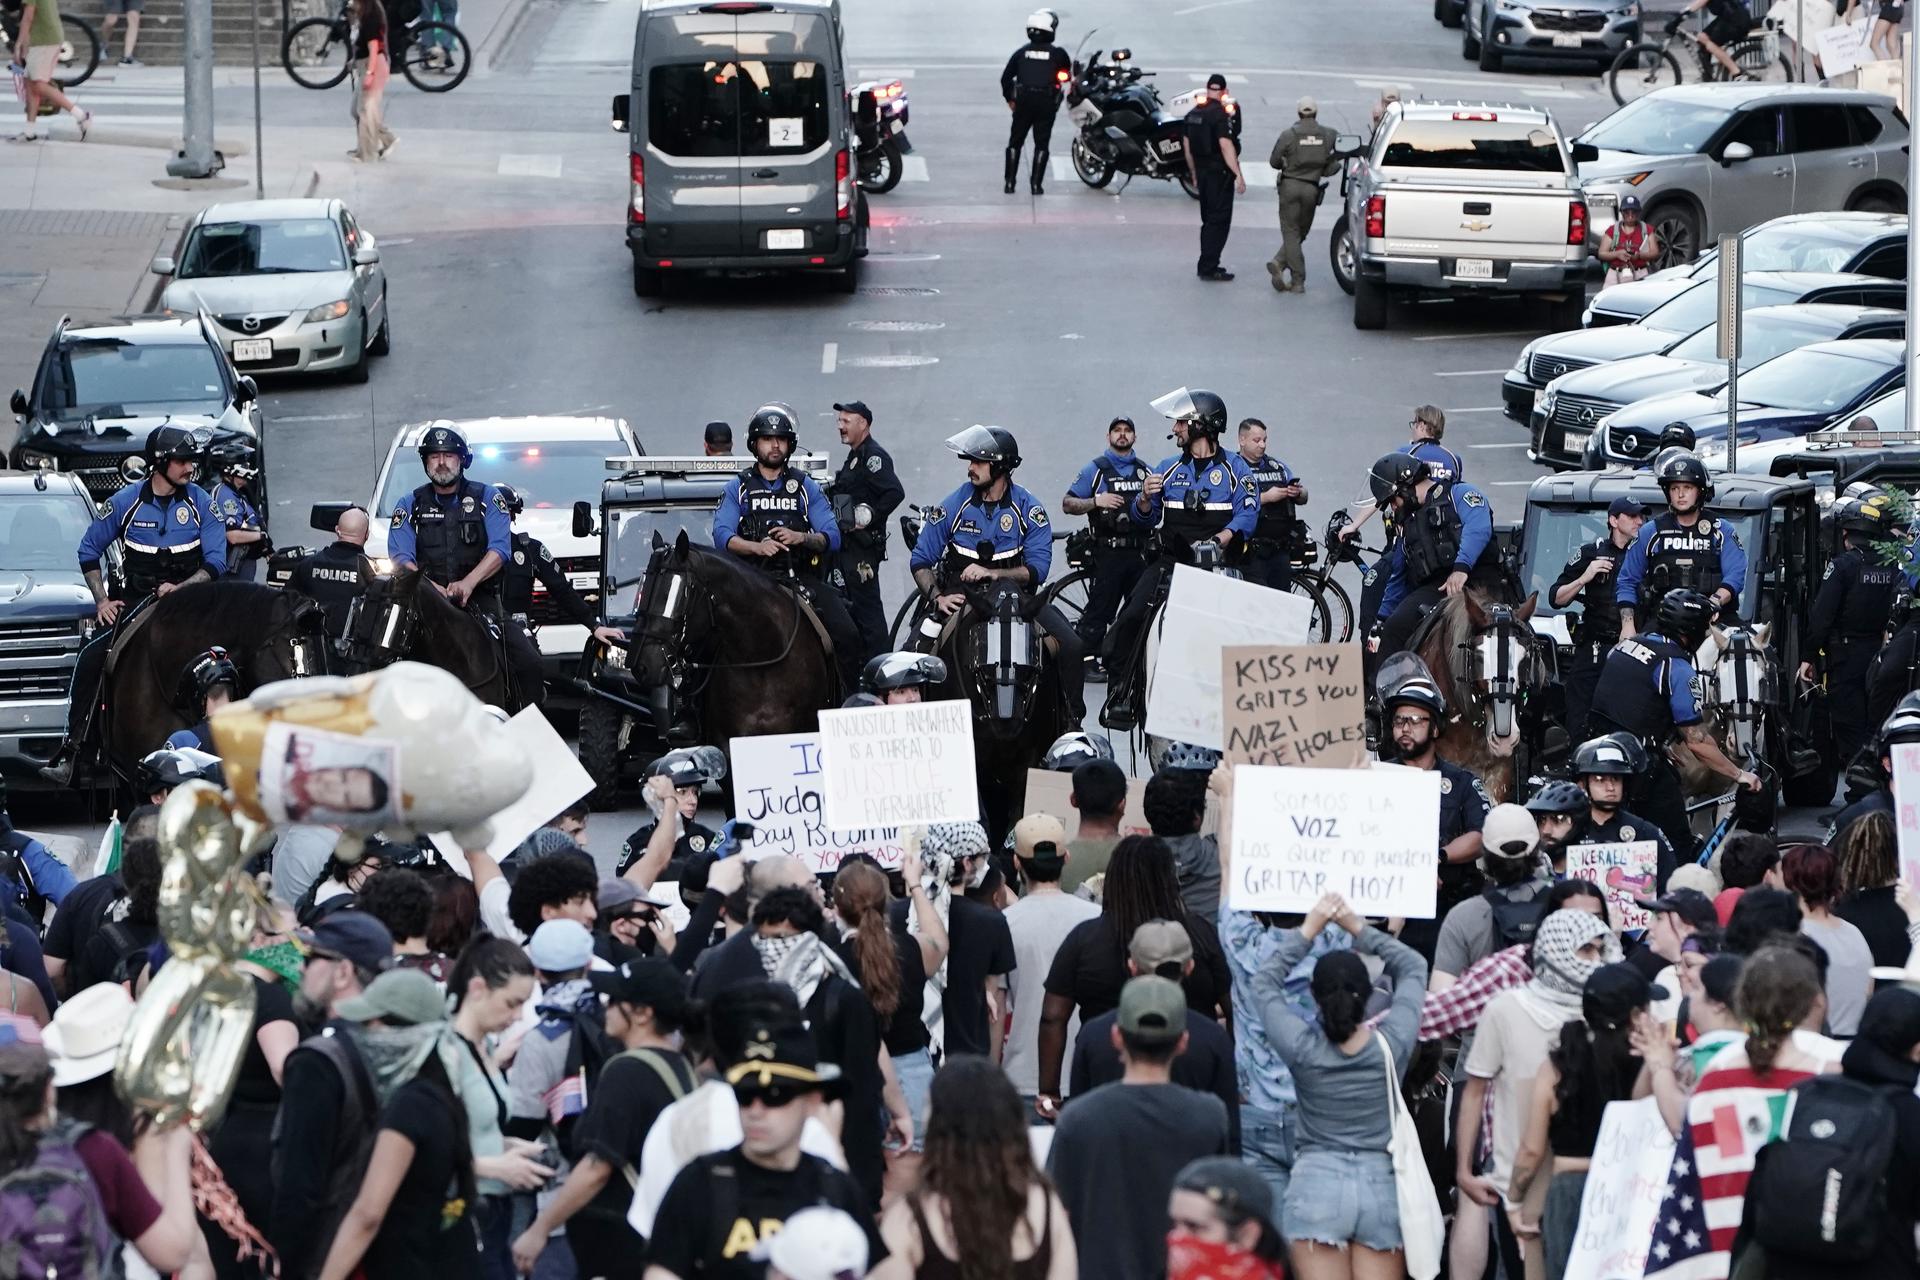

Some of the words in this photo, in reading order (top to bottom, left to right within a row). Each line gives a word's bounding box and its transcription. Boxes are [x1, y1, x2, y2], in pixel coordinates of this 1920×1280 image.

[782, 129, 789, 141] 2
[752, 498, 798, 510] POLICE
[1664, 538, 1711, 550] POLICE
[312, 567, 357, 584] POLICE
[1235, 654, 1296, 687] KISS
[1305, 654, 1339, 675] MY
[1236, 688, 1308, 712] GRITS
[1318, 684, 1358, 701] YOU
[905, 704, 966, 734] ANYWHERE
[1229, 715, 1298, 752] NAZI
[1295, 722, 1366, 763] HOLES
[849, 742, 861, 760] IS
[866, 743, 874, 760] A
[879, 737, 922, 760] THREAT
[929, 737, 943, 760] TO
[836, 759, 945, 801] JUSTICE
[748, 786, 824, 830] Judg
[1273, 791, 1349, 813] SOMOS
[1368, 795, 1394, 814] LA
[1291, 815, 1341, 838] VOZ
[1244, 865, 1327, 897] GRITAR
[1350, 875, 1404, 901] HOY!
